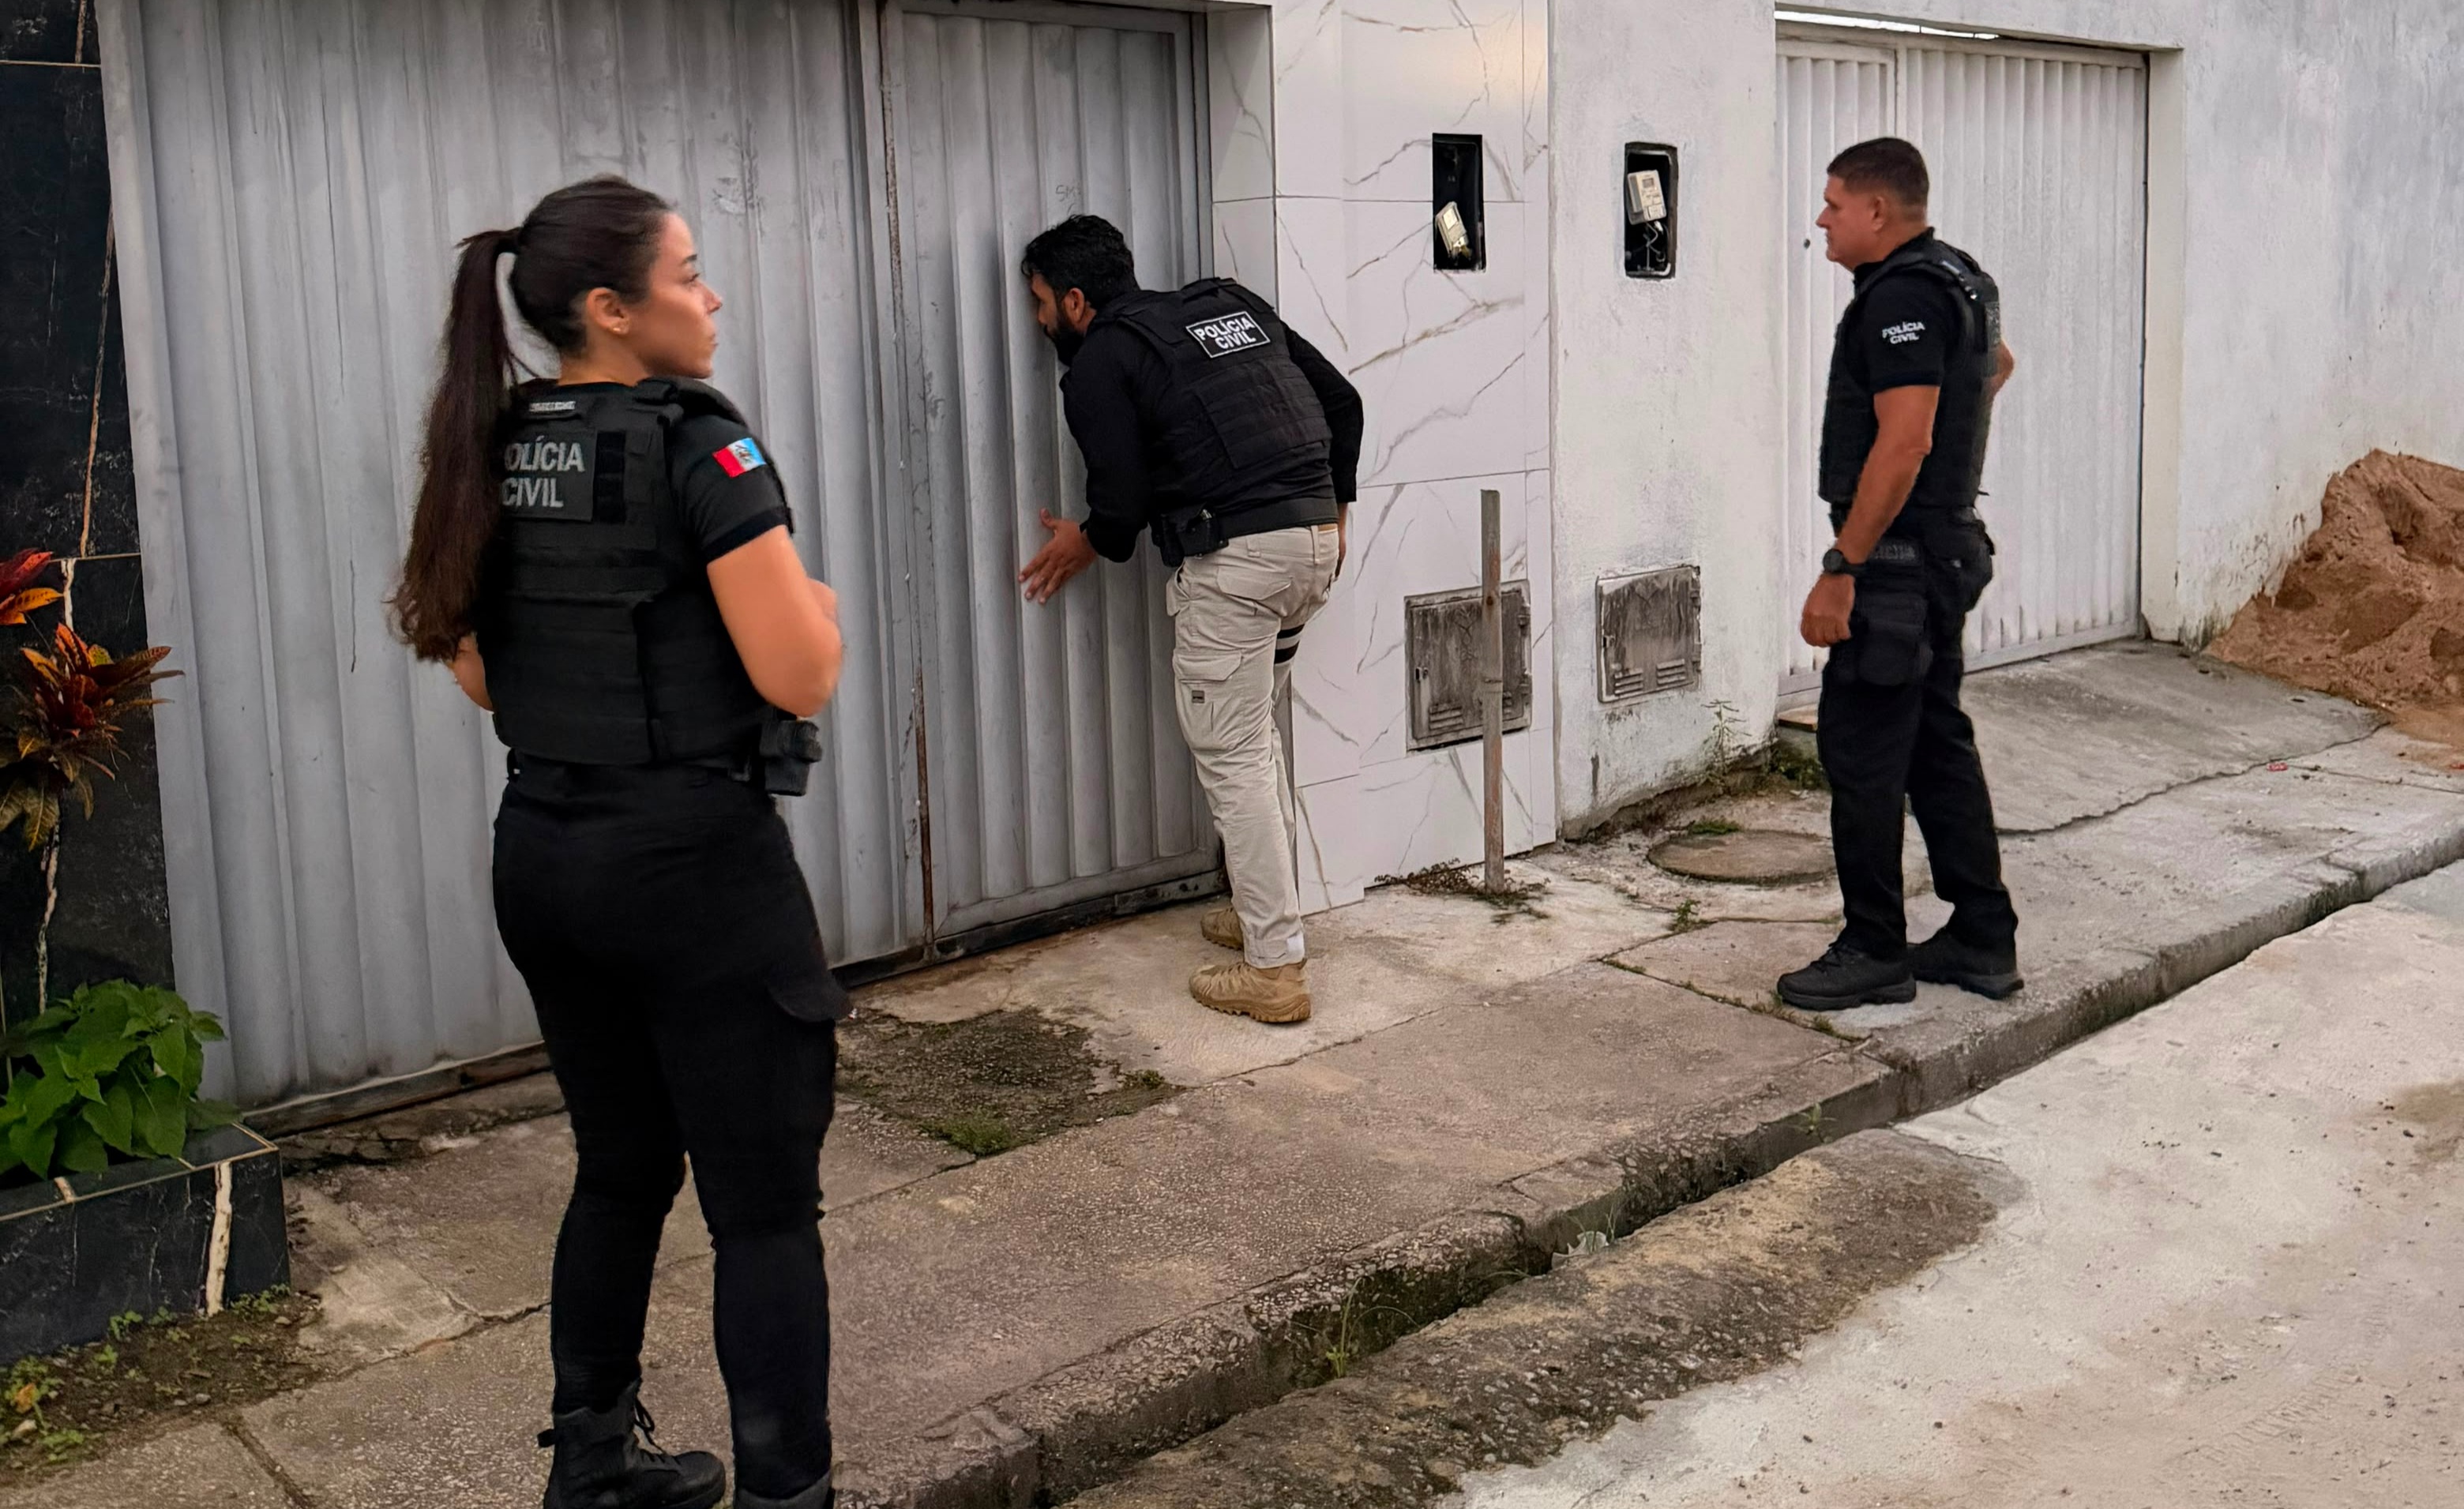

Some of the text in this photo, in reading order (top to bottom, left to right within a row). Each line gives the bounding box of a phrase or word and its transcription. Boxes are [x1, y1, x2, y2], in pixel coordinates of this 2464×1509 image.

[1193, 317, 1256, 340] POLÍCIA
[1882, 321, 1925, 339] POLÍCIA
[1889, 332, 1920, 344] CIVIL
[1215, 331, 1256, 350] CIVIL
[504, 434, 586, 472] OLÍCIA
[501, 477, 564, 508] CIVIL
